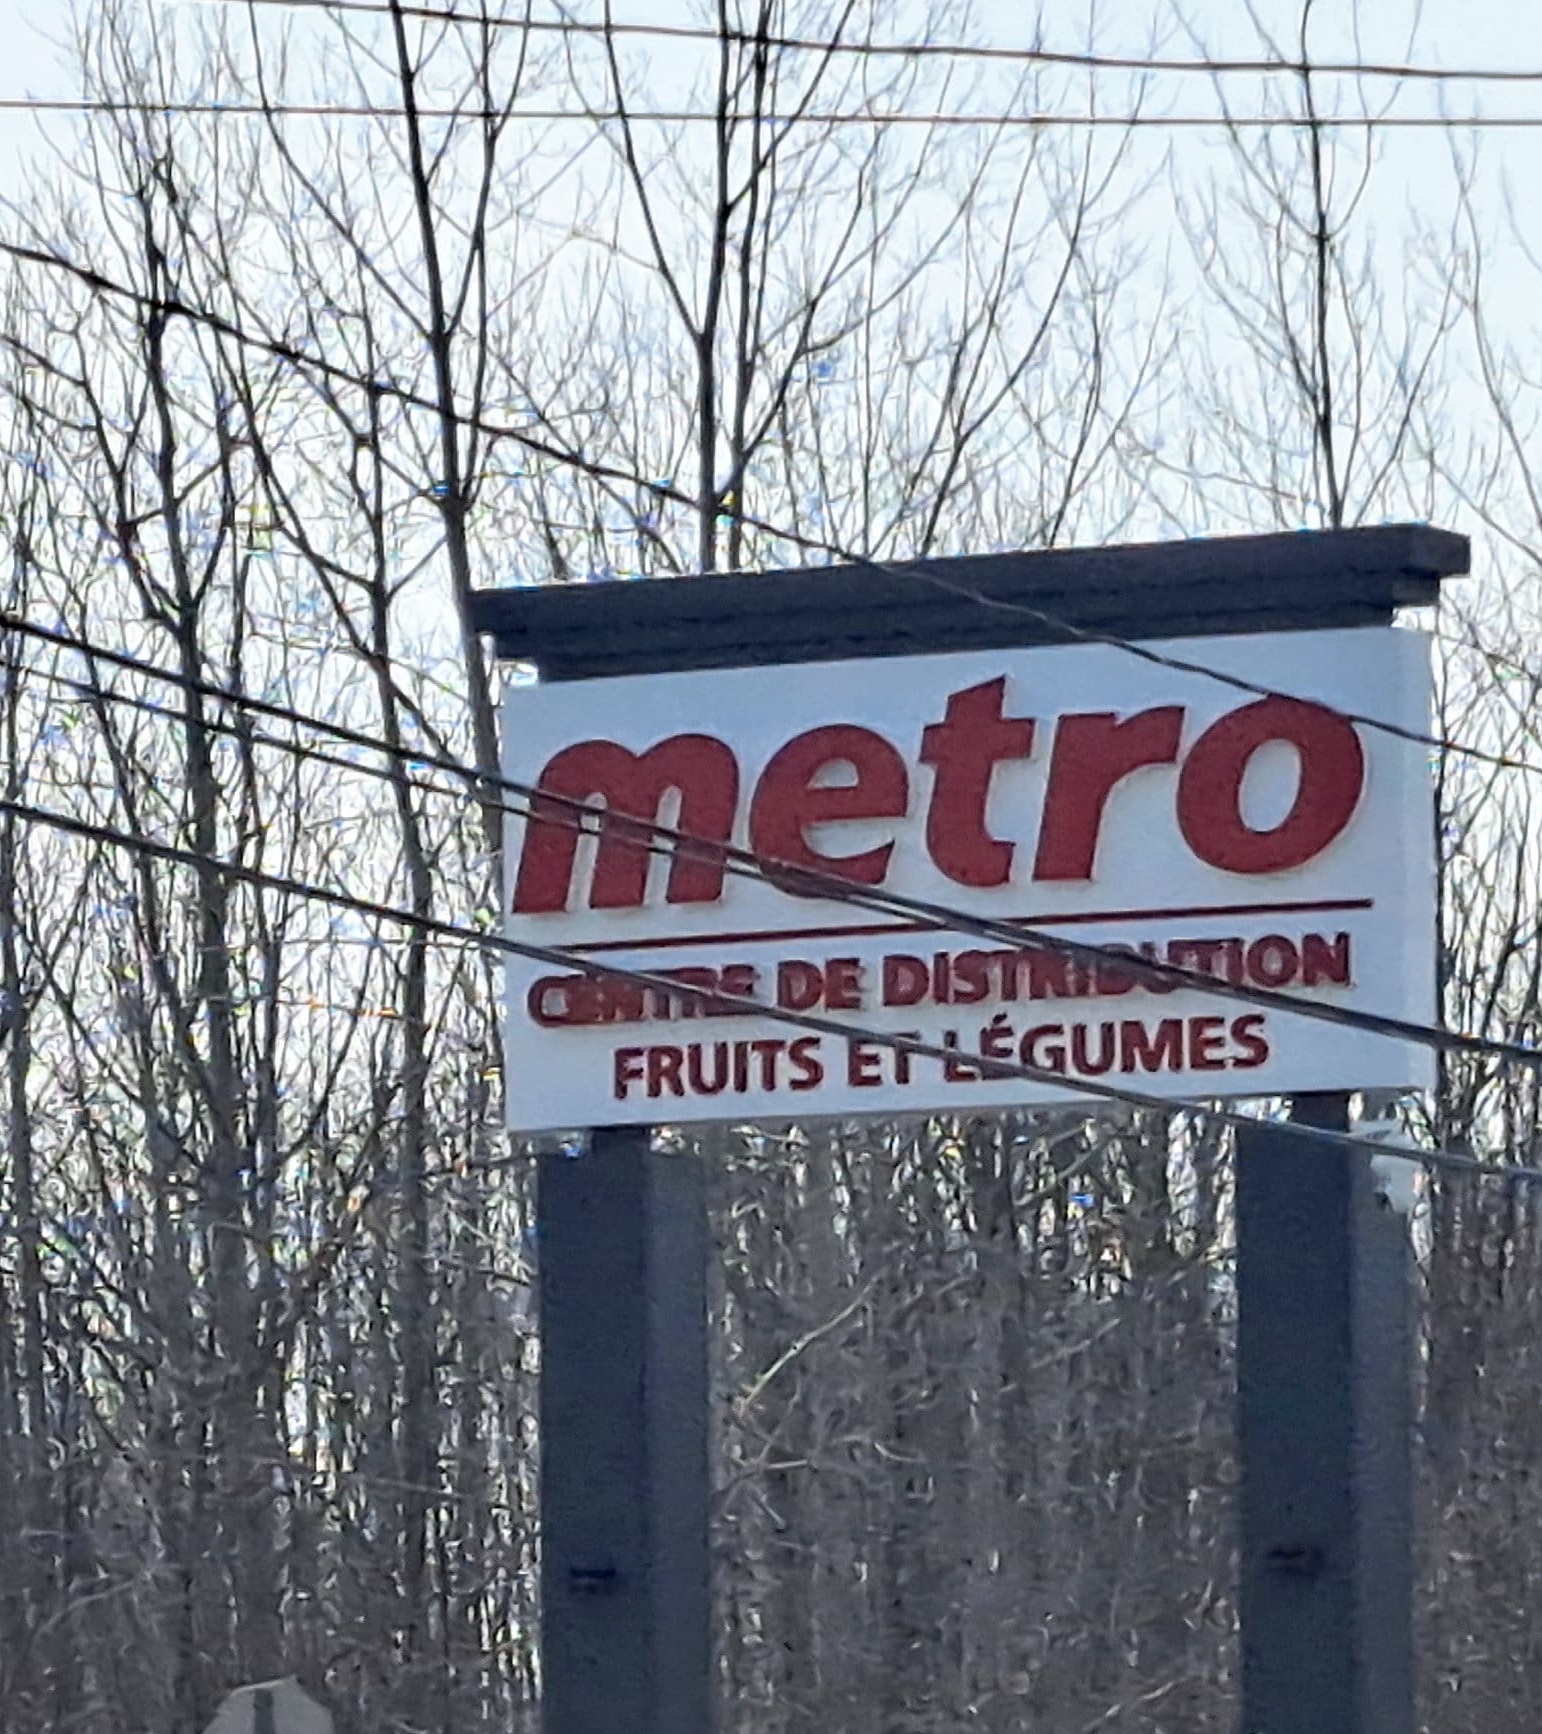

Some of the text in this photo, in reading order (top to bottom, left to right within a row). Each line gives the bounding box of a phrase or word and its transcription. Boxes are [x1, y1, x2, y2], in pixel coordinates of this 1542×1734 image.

[512, 675, 1366, 914] metro
[776, 957, 865, 1014] DE
[883, 931, 1352, 1008] DISTRIBUTION
[613, 1012, 1270, 1100] FRUITS ET LÉGUMES
